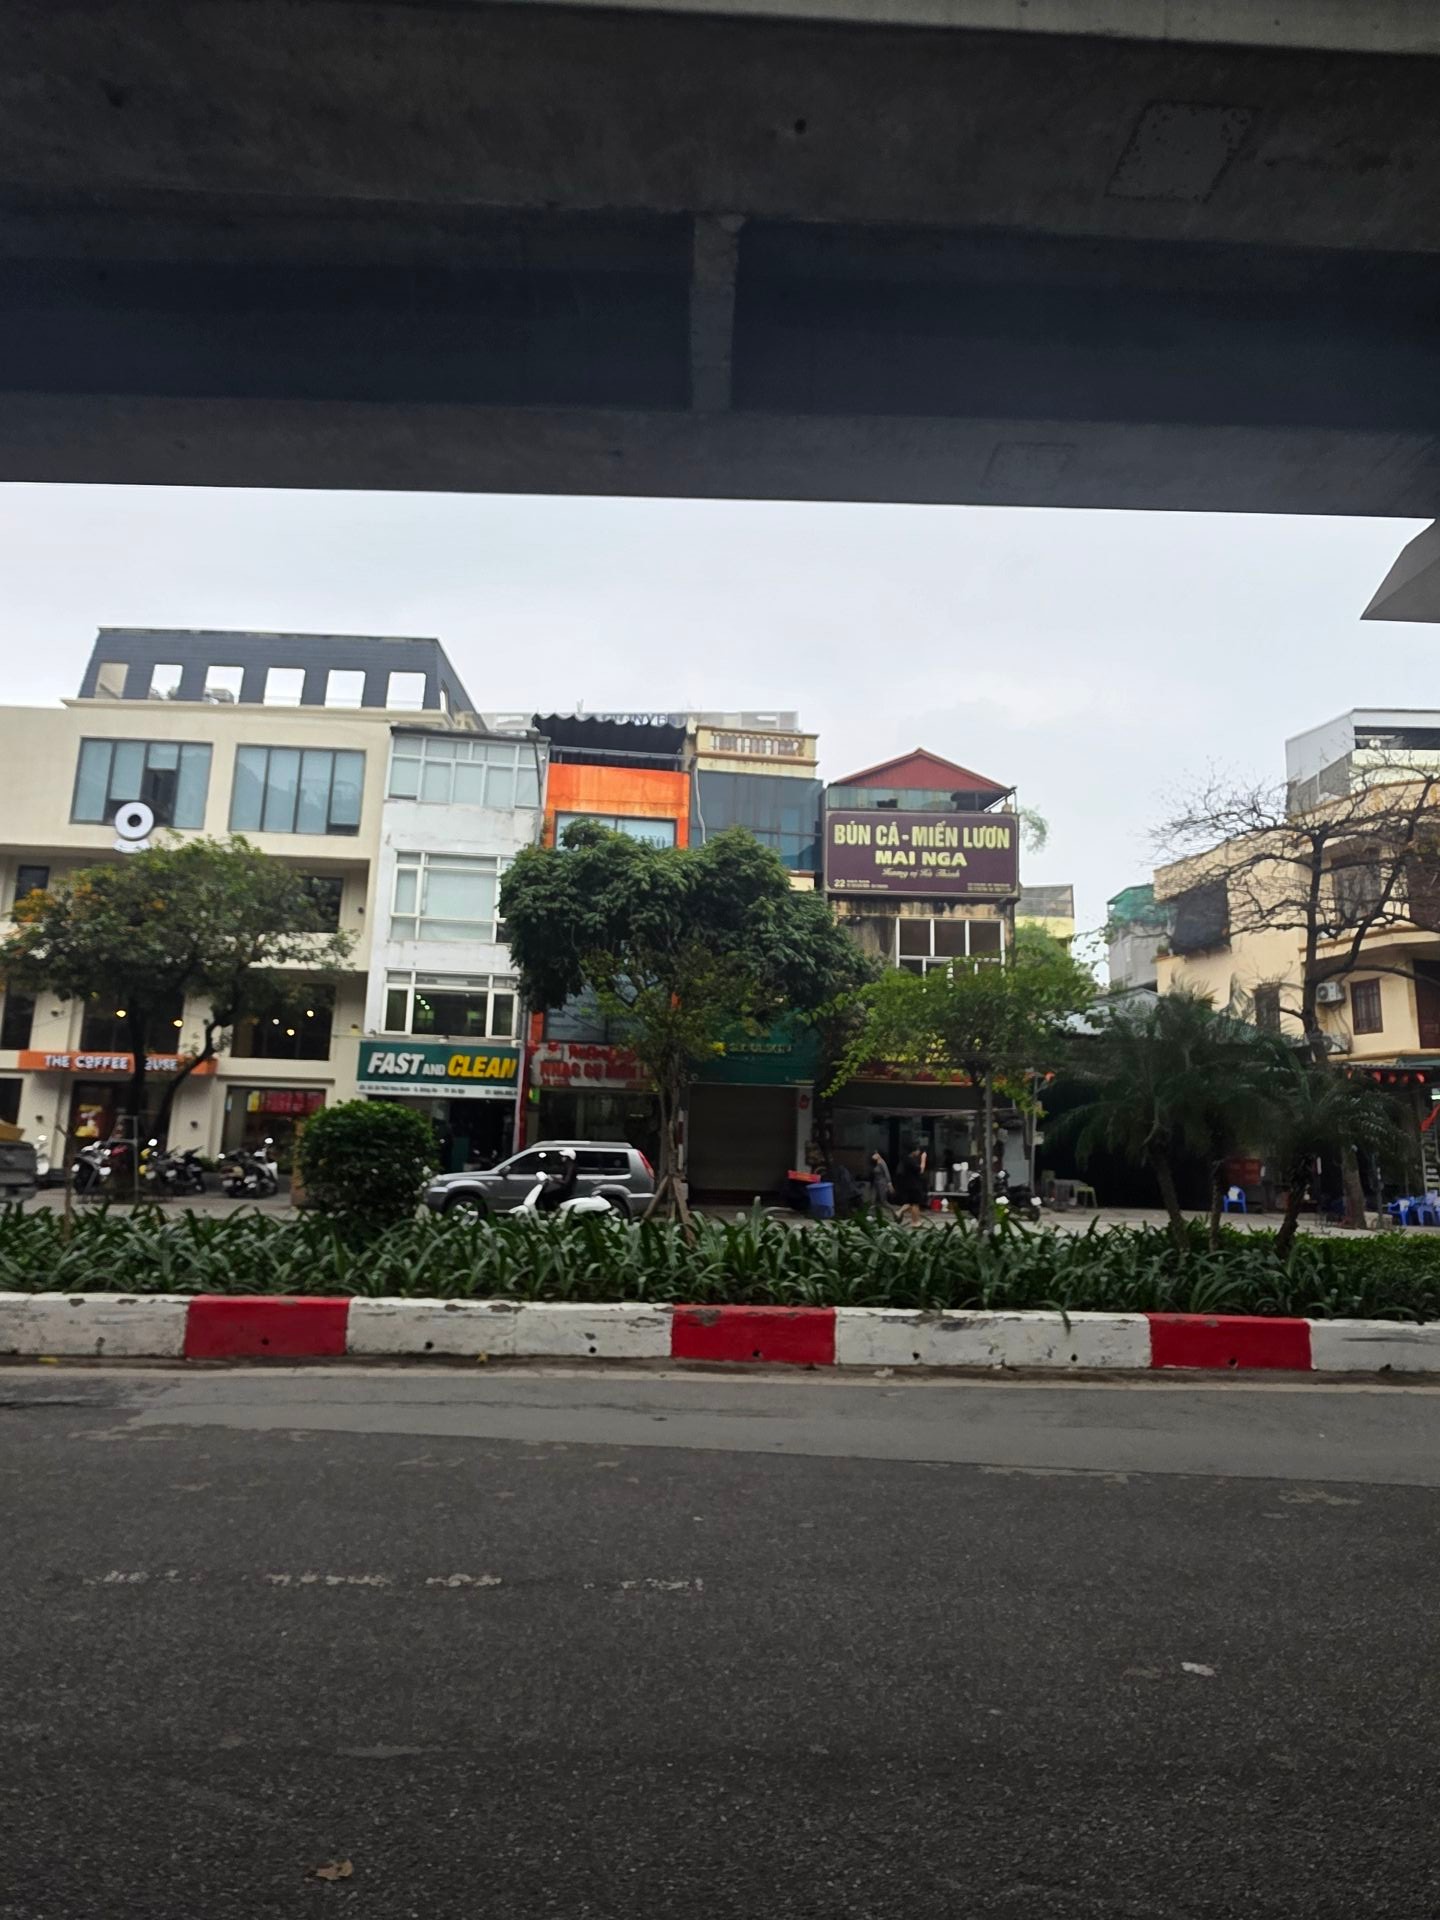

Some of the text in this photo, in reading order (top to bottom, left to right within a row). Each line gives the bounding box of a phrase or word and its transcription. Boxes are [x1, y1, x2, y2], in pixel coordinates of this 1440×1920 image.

[834, 820, 871, 845] BÚN
[876, 821, 900, 846] CÁ
[963, 825, 1011, 849] LƯƠN
[875, 850, 968, 867] MAI NGA
[834, 878, 846, 888] 22
[44, 1055, 178, 1072] THE COFFEE OUSE
[367, 1052, 518, 1079] FAST AND CLEAN
